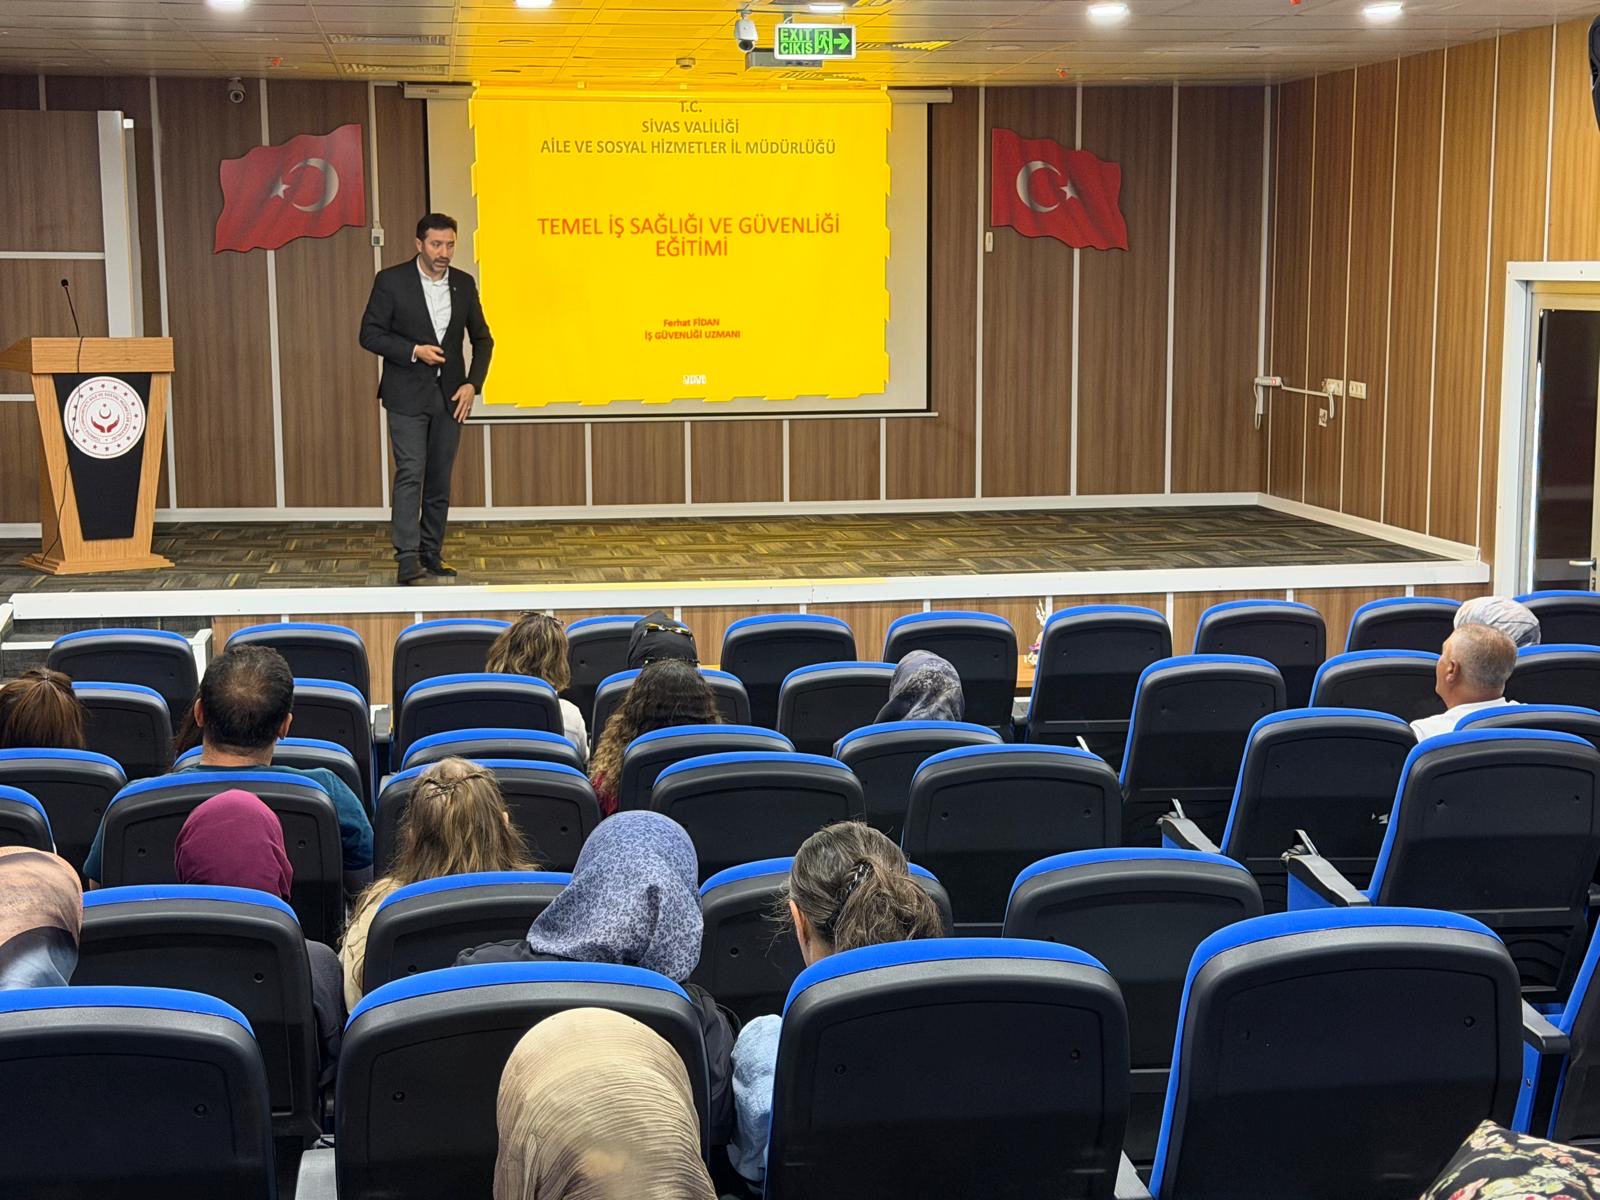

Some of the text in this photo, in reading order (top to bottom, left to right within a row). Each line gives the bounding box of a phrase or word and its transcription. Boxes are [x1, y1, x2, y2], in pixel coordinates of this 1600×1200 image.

[780, 28, 812, 41] EXIT
[680, 100, 702, 113] T.C.
[642, 119, 739, 133] SİVAS VALİLİĞİ
[541, 138, 836, 155] AİLE VE SOSYAL HİZMETLER İL MÜDÜRLÜĞÜ
[537, 213, 840, 238] TEMEL İŞ SAĞLIĞI VE GÜVENLİĞİ
[655, 236, 728, 257] EĞİTİMİ
[663, 318, 720, 327] Ferhat FİDAN
[644, 330, 740, 341] İŞ GÜVENLİĞİ UZMANI
